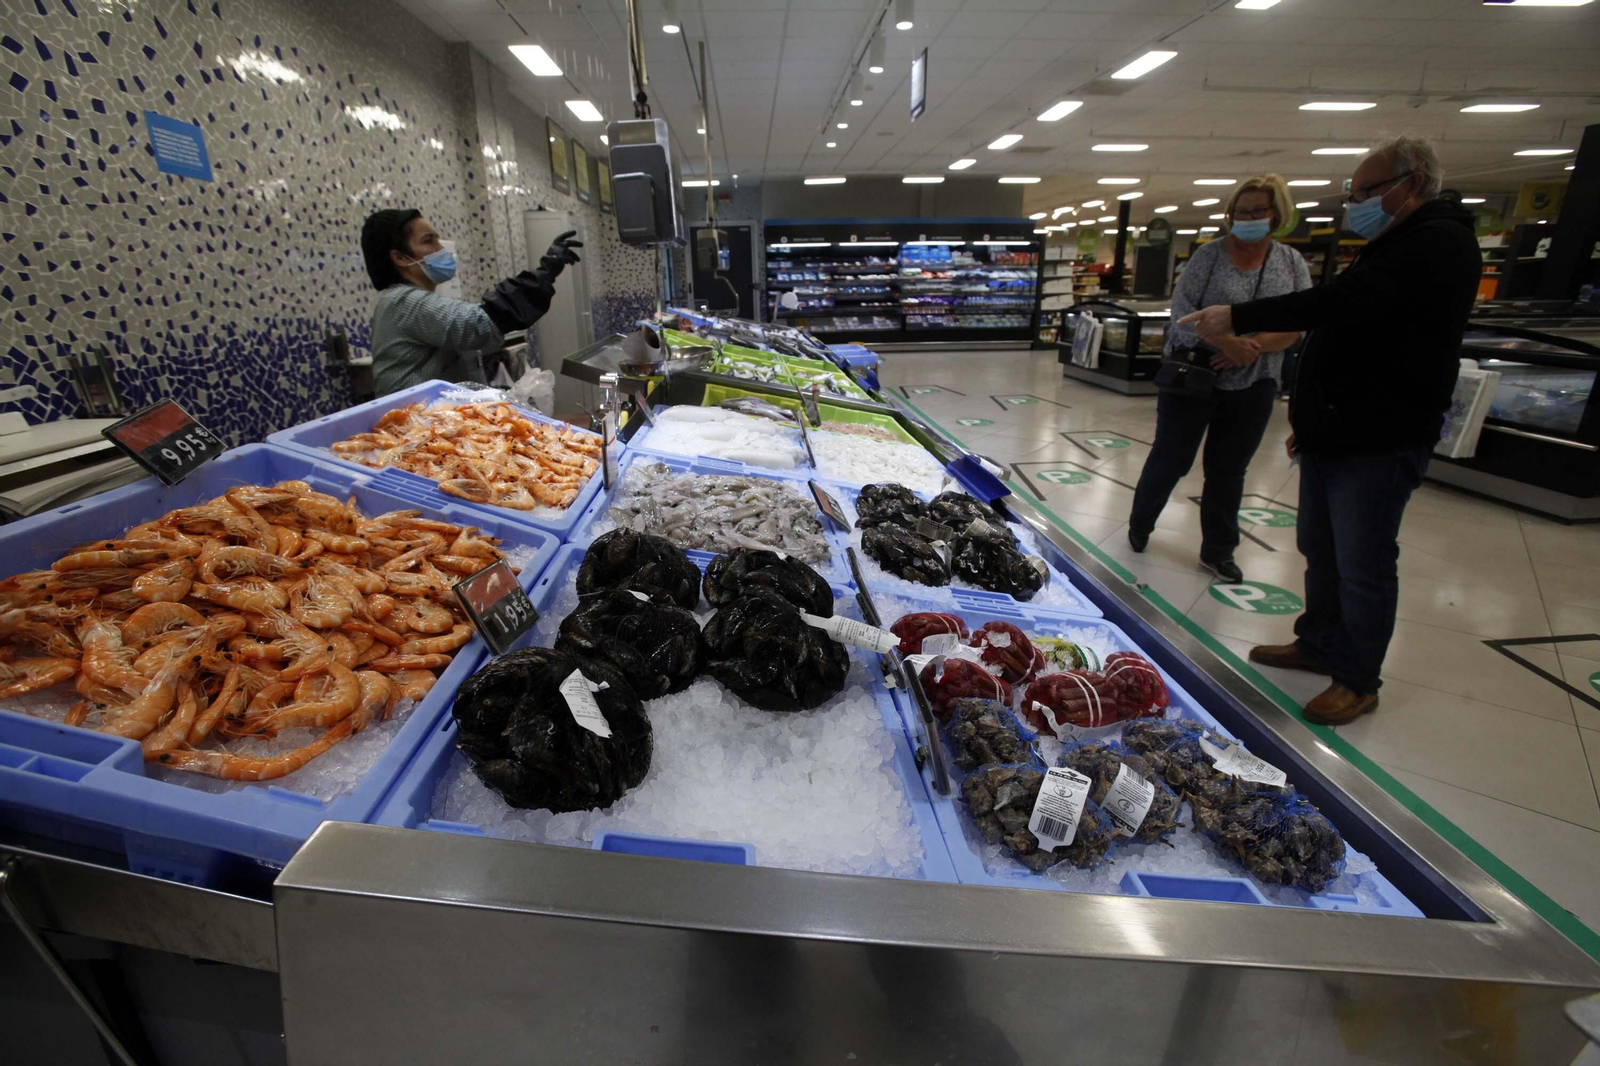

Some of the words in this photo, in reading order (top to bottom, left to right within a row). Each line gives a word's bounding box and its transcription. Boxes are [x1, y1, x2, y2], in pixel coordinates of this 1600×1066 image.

[1040, 471, 1071, 484] P
[1238, 509, 1275, 526] P
[1212, 584, 1267, 611] P
